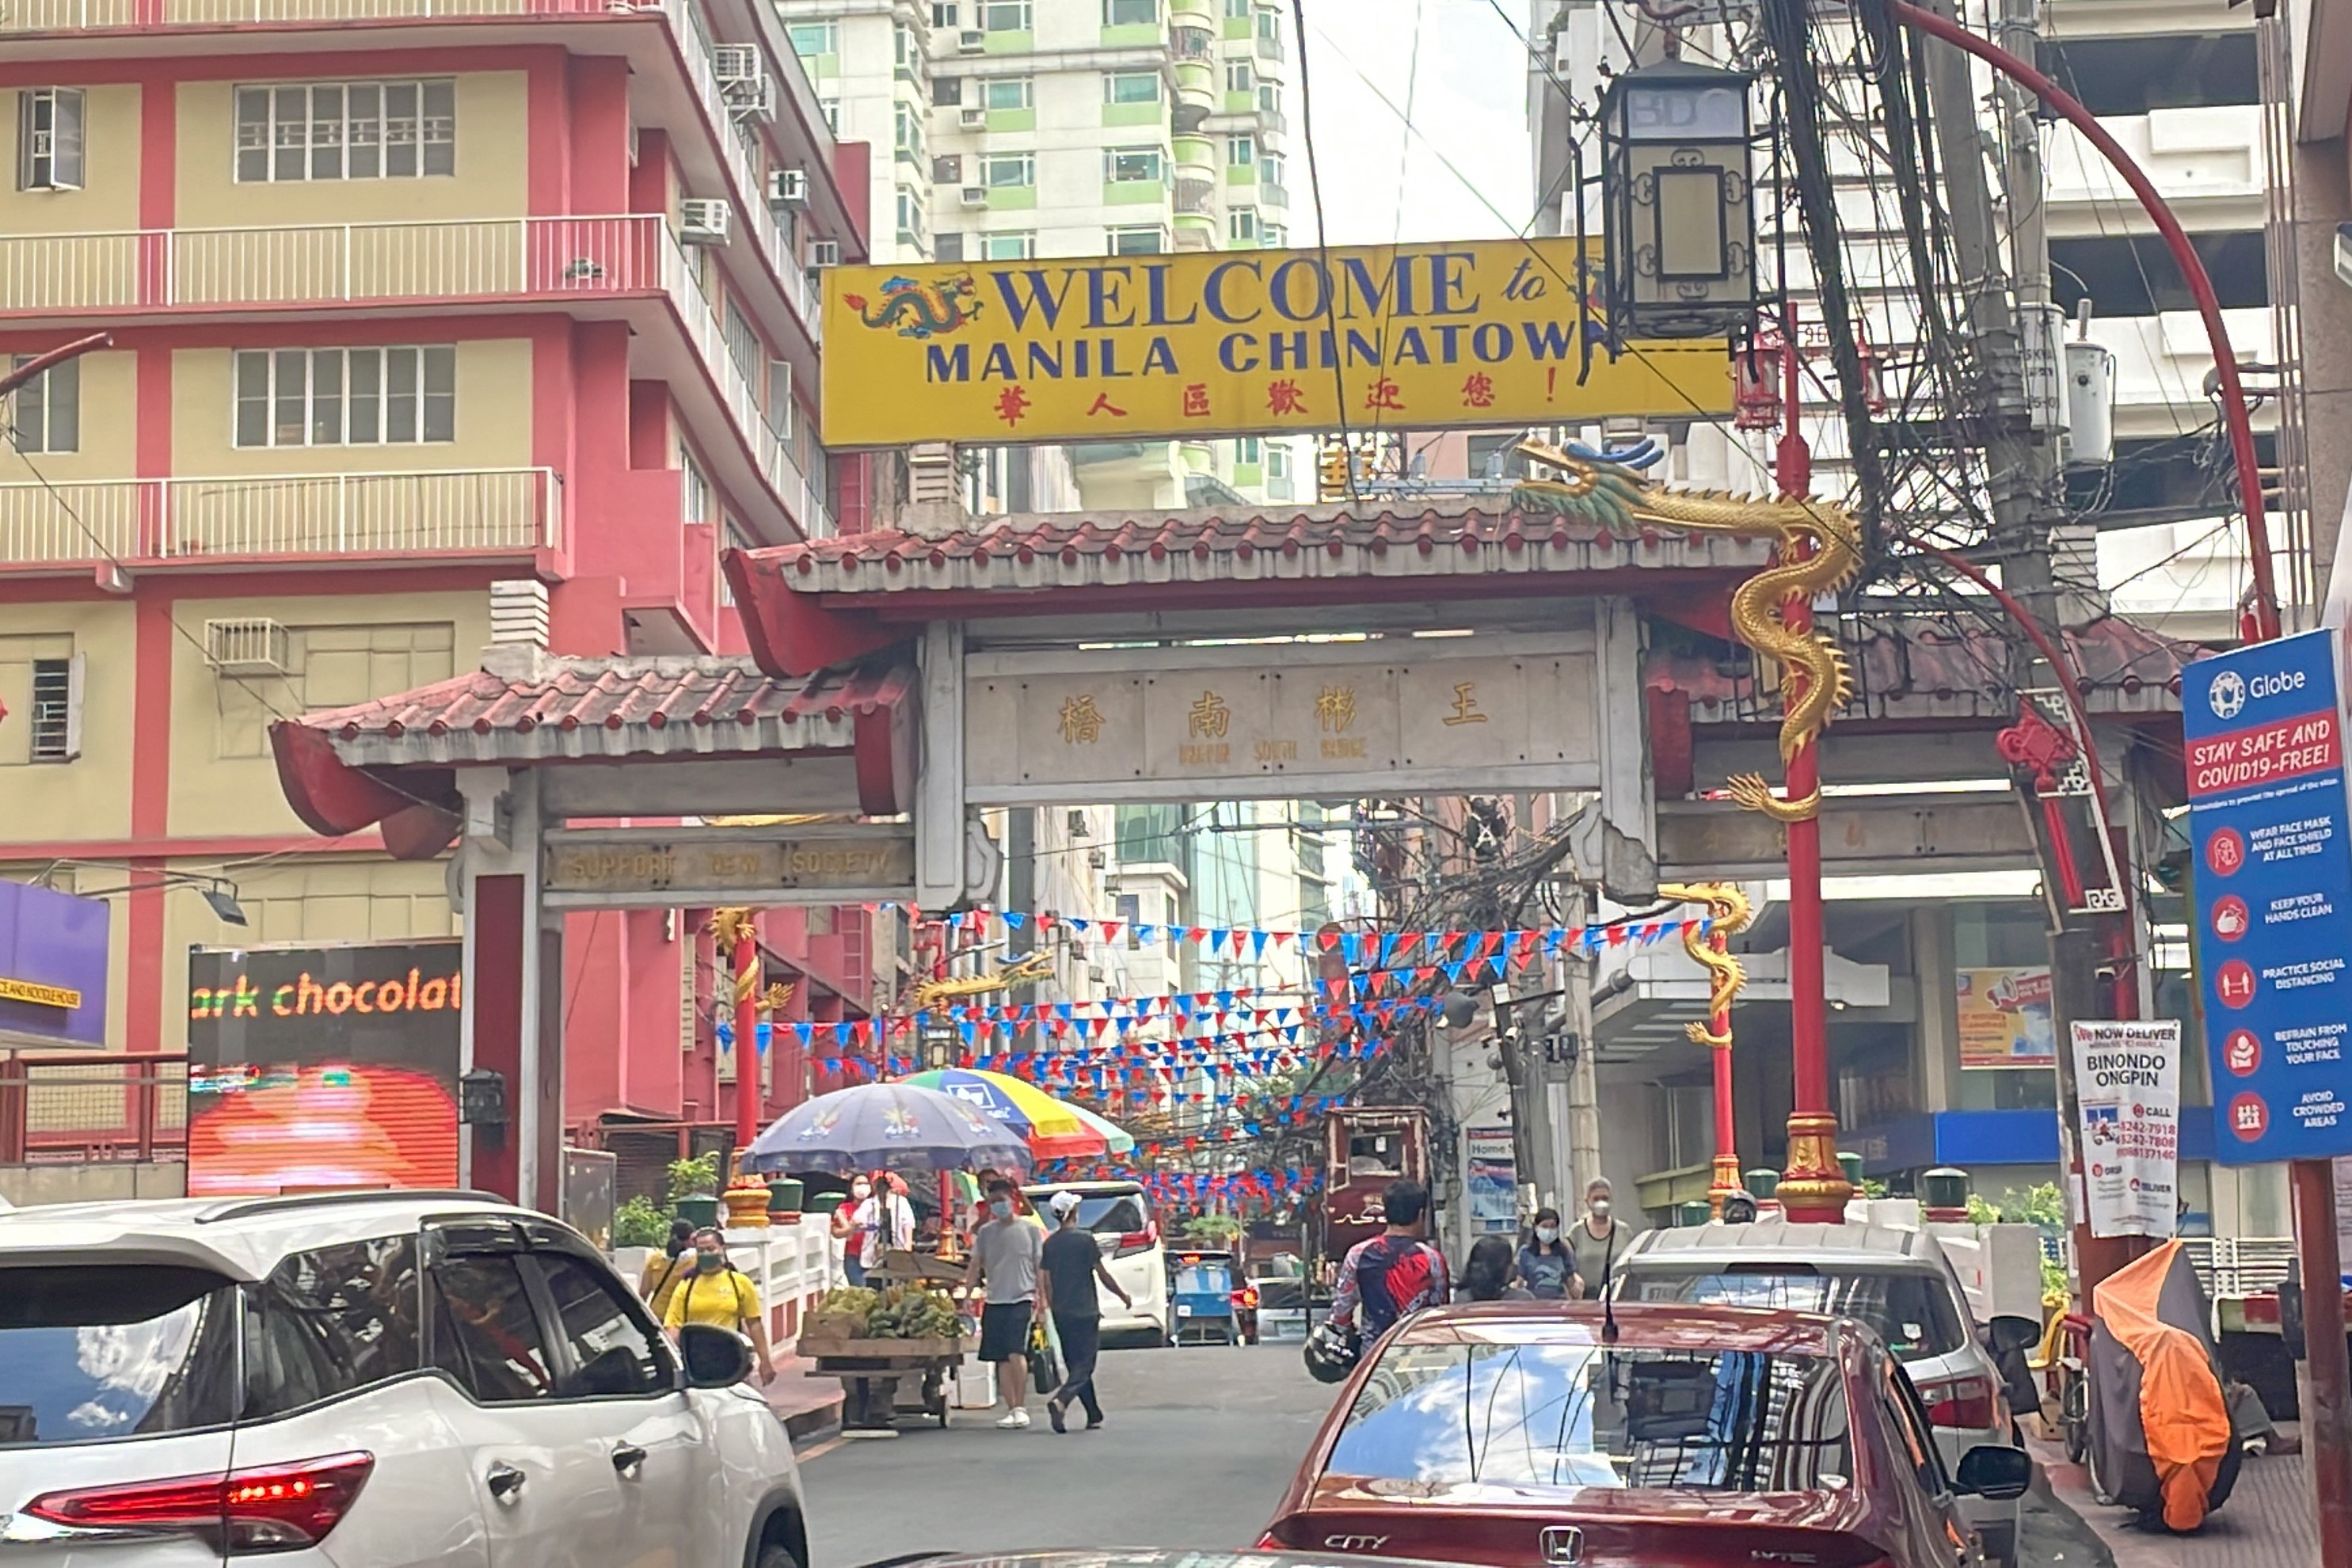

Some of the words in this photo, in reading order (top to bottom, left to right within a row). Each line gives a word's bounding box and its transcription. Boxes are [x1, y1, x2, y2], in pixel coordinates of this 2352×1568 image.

[990, 250, 1479, 331] WELCOME
[1501, 257, 1547, 303] to
[926, 335, 1179, 383] MANILA
[2250, 671, 2305, 698] Globe
[2194, 741, 2236, 766] STAY
[2240, 729, 2288, 757] SAFE
[2291, 719, 2330, 746] AND
[2198, 744, 2330, 789] COVID19-FREE!
[2279, 820, 2303, 835] FACE
[2304, 816, 2331, 830] MASK
[2251, 839, 2273, 853] AND
[2274, 835, 2297, 848] FACE
[2297, 828, 2332, 844] SHIELD
[2263, 851, 2274, 862] AT
[2275, 847, 2293, 861] ALL
[2294, 842, 2323, 857] TIMES
[2270, 898, 2295, 911] KEEP
[2265, 910, 2300, 923] HANDS
[2301, 904, 2332, 919] CLEAN
[2263, 964, 2309, 980] PRACTICE
[2309, 958, 2346, 972] SOCIAL
[2275, 972, 2335, 990] DISTANCING
[2076, 1026, 2093, 1041] We
[2095, 1028, 2122, 1040] NOW
[2126, 1028, 2176, 1041] DELIVER
[2274, 1026, 2316, 1041] REFRAIN
[2319, 1024, 2347, 1035] FROM
[2285, 1037, 2339, 1052] TOUCHING
[2087, 1053, 2166, 1071] BINONDO
[2286, 1052, 2315, 1065] YOUR
[2316, 1048, 2341, 1060] FACE
[2096, 1071, 2159, 1087] ONGPIN
[2301, 1090, 2334, 1104] AVOID
[2145, 1106, 2171, 1117] CALL
[2293, 1102, 2345, 1117] CROWDED
[2304, 1115, 2337, 1128] AREAS
[1472, 1144, 1505, 1154] Home
[1324, 1534, 1391, 1550] CITY
